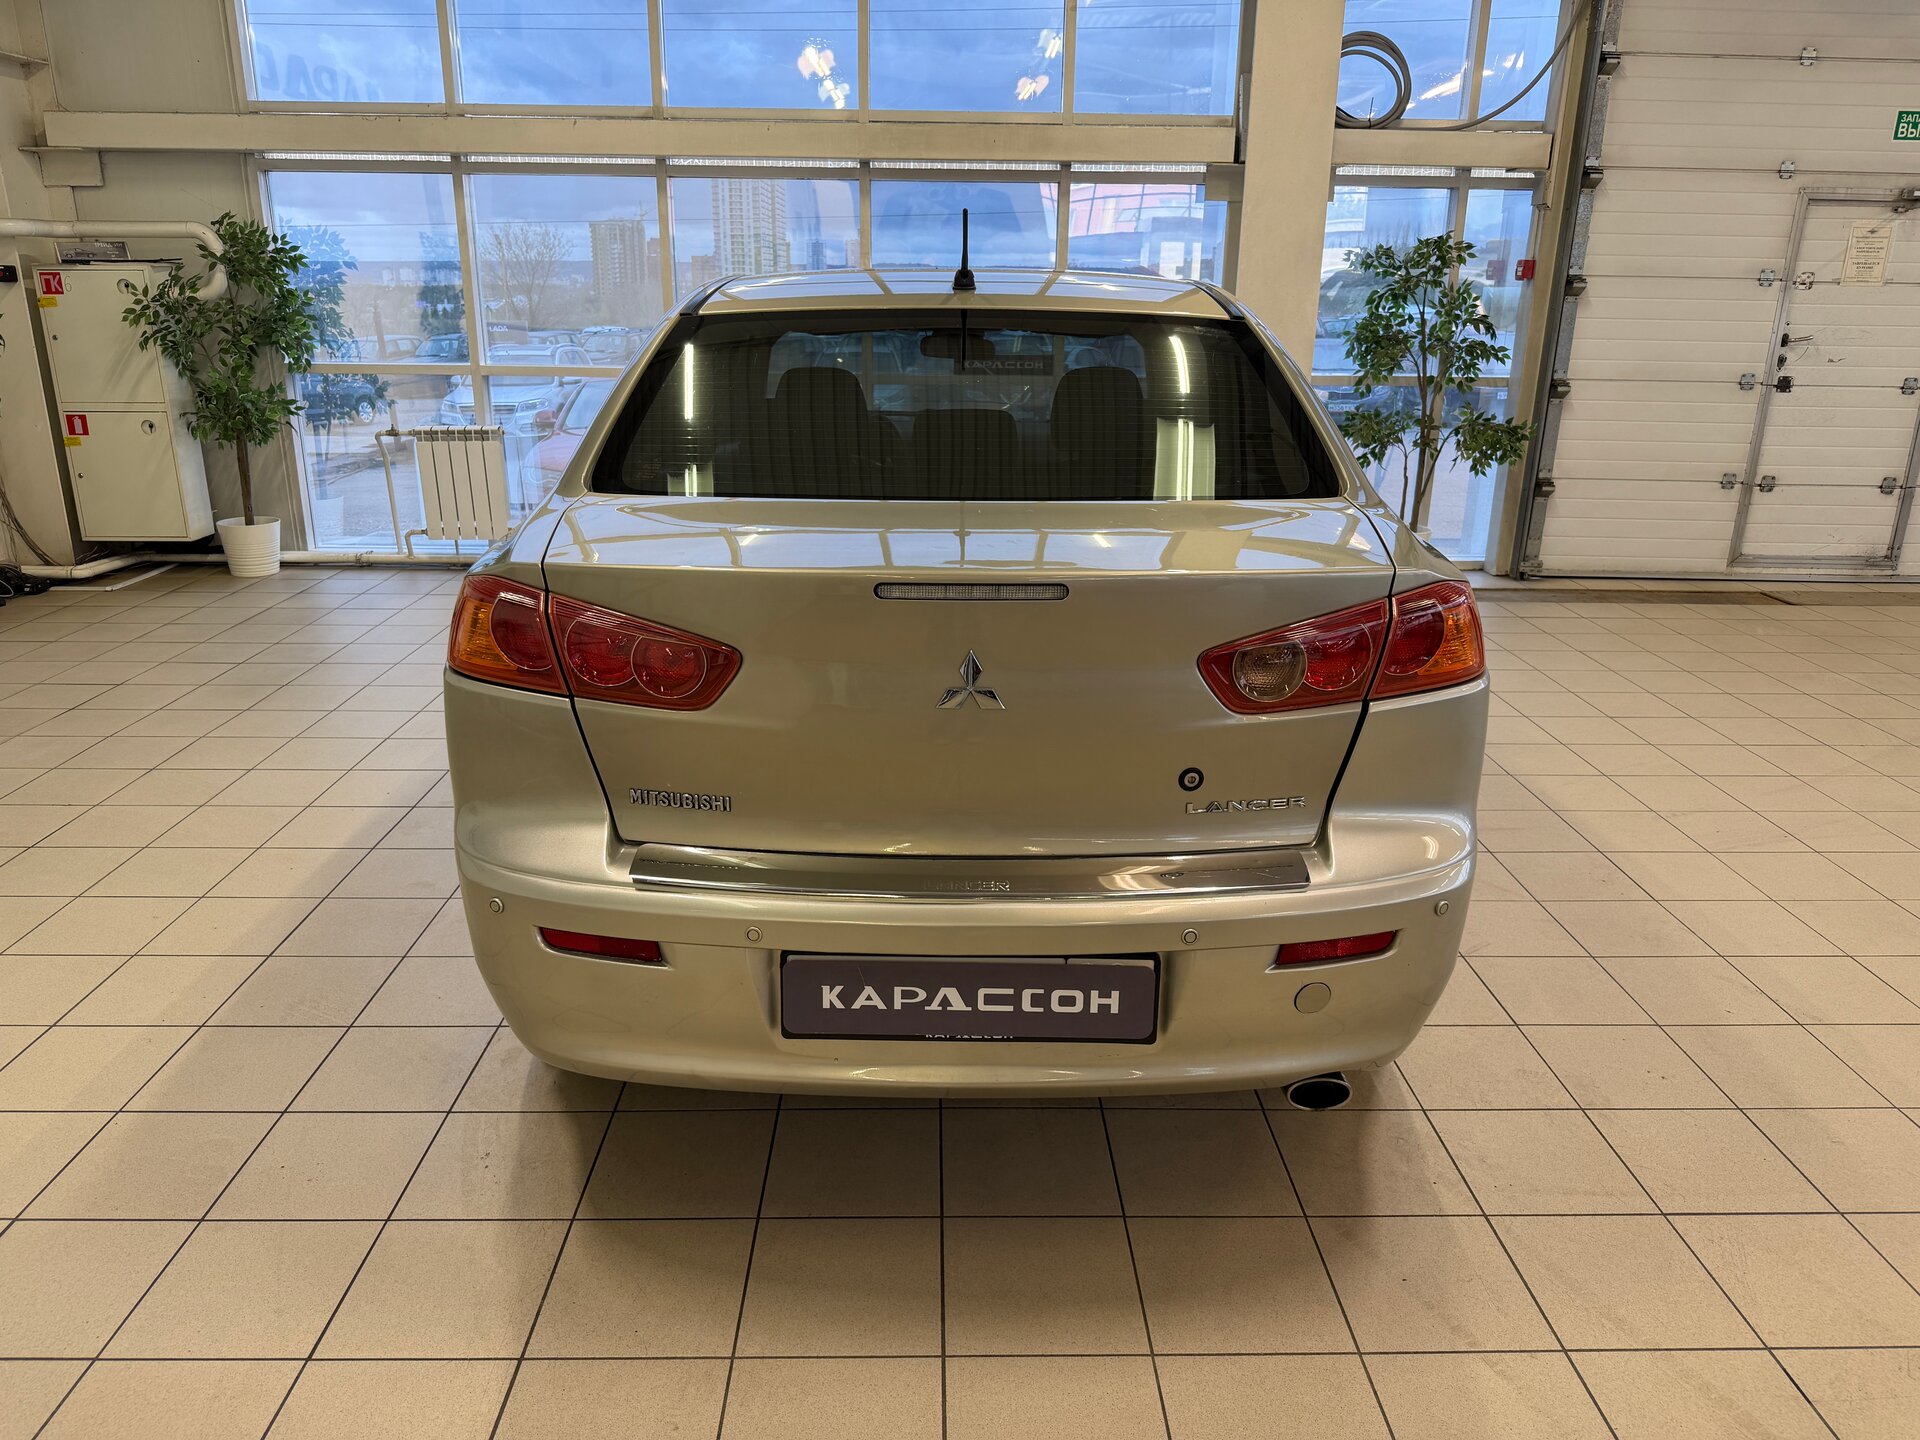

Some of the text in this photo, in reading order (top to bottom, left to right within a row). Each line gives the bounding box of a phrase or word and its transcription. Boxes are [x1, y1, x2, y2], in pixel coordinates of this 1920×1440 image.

[1900, 113, 1920, 122] ЗАП
[1897, 123, 1920, 137] ВЫ
[40, 274, 63, 292] ПК
[65, 275, 72, 293] 6
[629, 788, 732, 812] MITSUBISHI
[1186, 796, 1306, 814] LANCER
[820, 985, 1120, 1014] КАРАССОН
